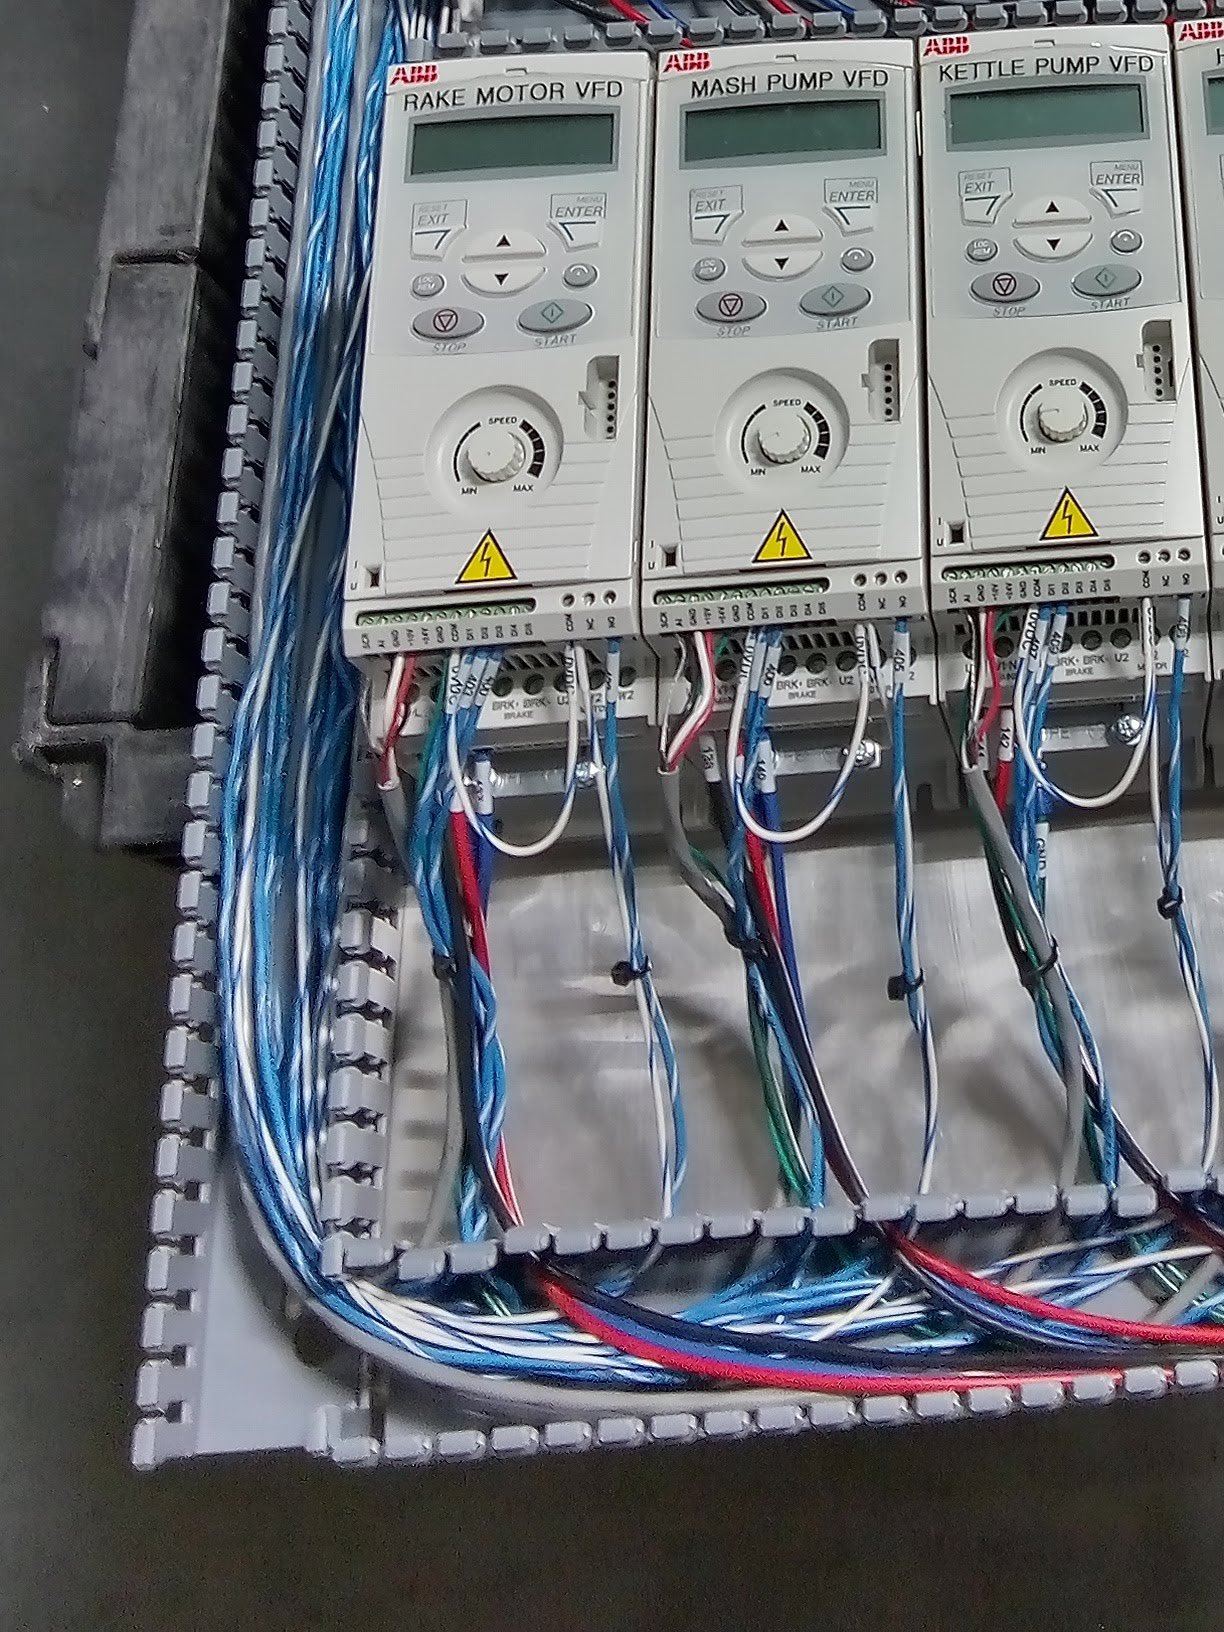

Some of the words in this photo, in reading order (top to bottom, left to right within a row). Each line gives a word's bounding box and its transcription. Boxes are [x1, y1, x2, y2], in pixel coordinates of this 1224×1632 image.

[923, 36, 970, 57] ABB
[663, 52, 710, 73] ABB
[939, 59, 1025, 82] KETTLE
[1035, 56, 1099, 74] PUMP
[1109, 55, 1153, 72] VFD
[390, 65, 437, 85] ABB
[691, 76, 756, 98] MASH
[767, 72, 832, 91] PUMP
[843, 70, 888, 87] VFD
[403, 88, 466, 112] RAKE
[476, 82, 565, 105] MOTOR
[576, 80, 623, 99] VFD
[1096, 173, 1140, 185] ENTER
[964, 180, 994, 193] EXIT
[829, 191, 875, 202] ENTER
[695, 199, 726, 211] EXIT
[555, 206, 603, 218] ENTER
[417, 213, 449, 226] EXIT
[1091, 298, 1130, 310] START
[993, 306, 1026, 316] STOP
[817, 317, 858, 329] START
[716, 326, 750, 336] STOP
[535, 334, 577, 346] START
[432, 342, 466, 353] STOP
[1115, 653, 1129, 662] U2
